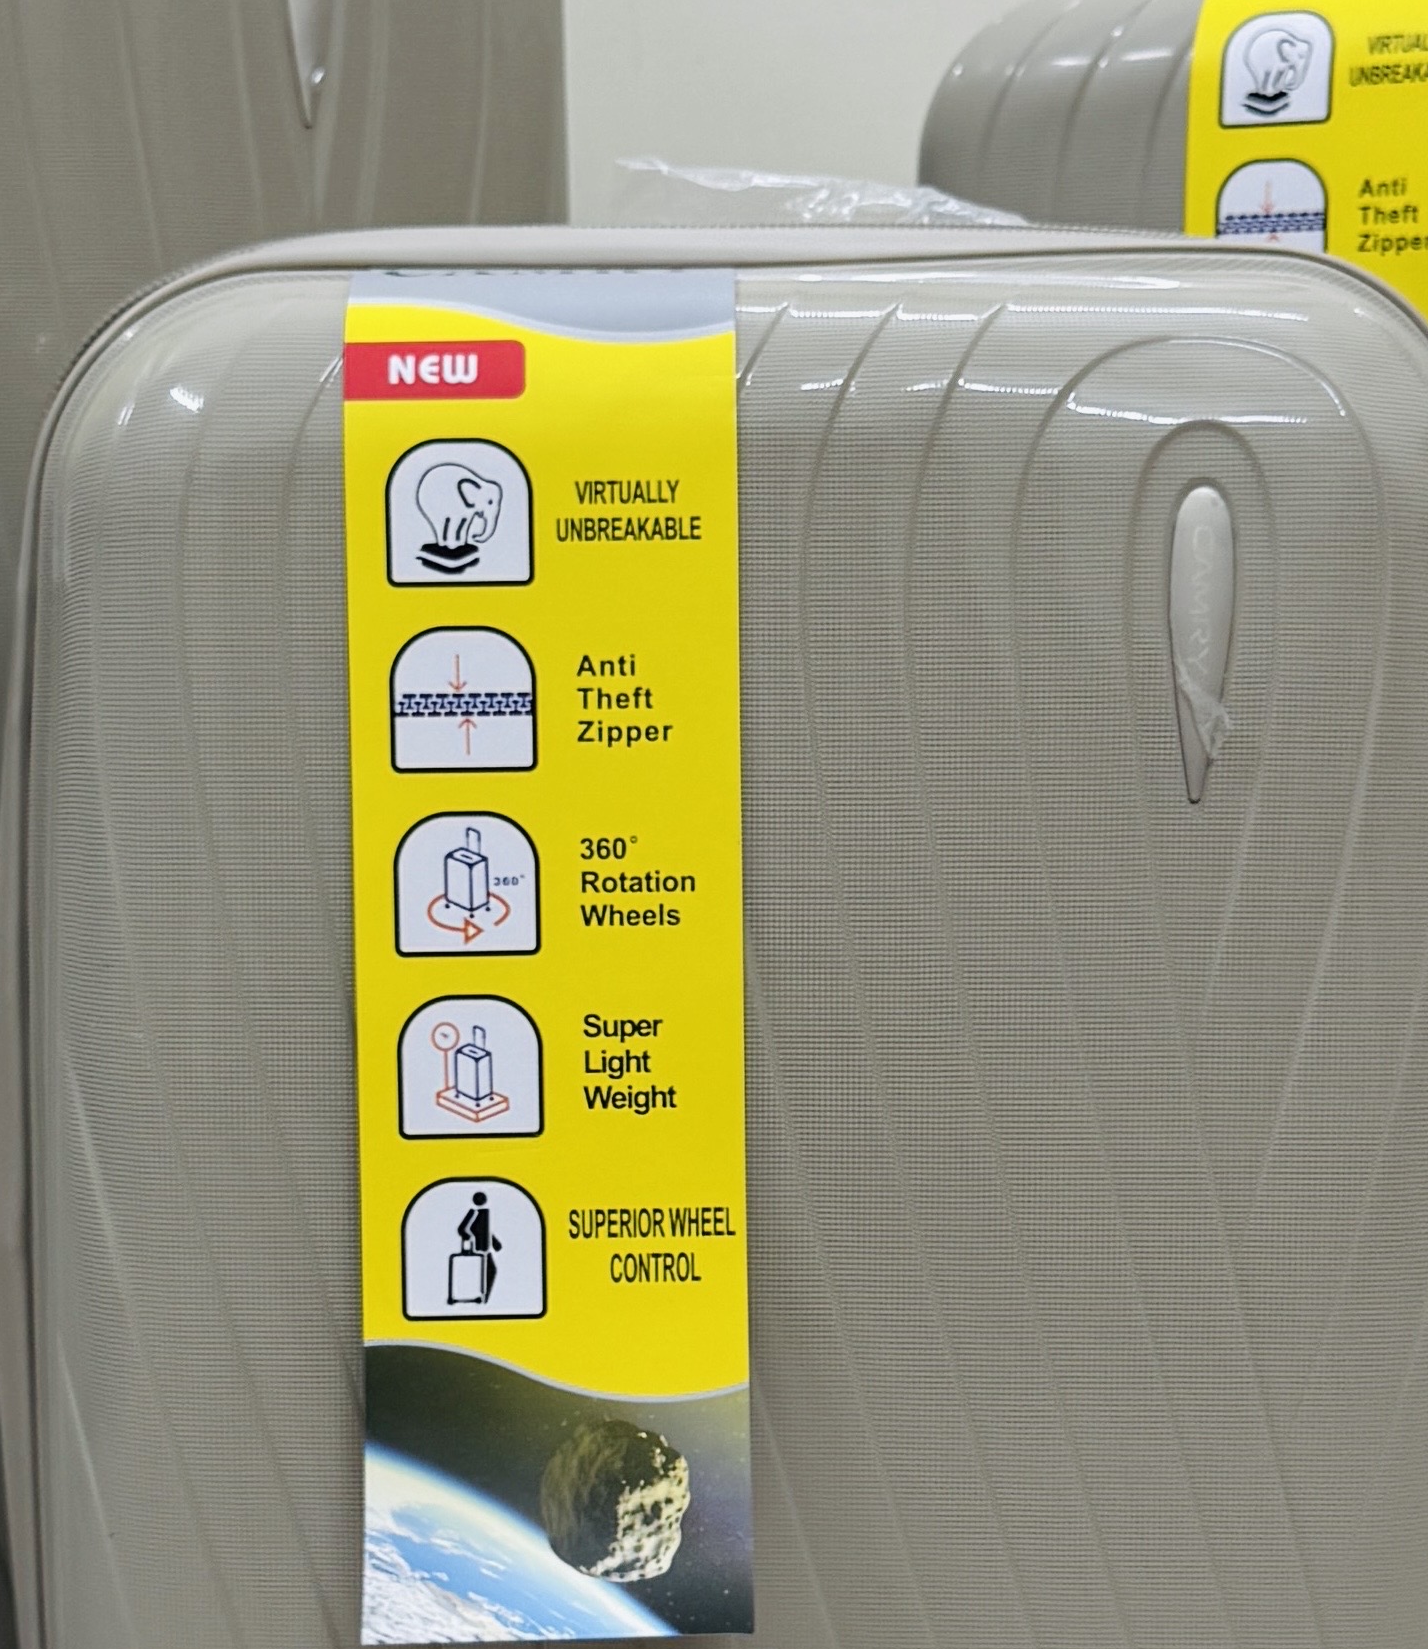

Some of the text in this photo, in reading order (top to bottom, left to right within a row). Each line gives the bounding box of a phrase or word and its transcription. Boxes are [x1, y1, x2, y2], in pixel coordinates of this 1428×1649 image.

[1359, 178, 1407, 198] Anti
[1358, 204, 1419, 225] Theft
[388, 353, 478, 385] NEW
[574, 479, 680, 505] VIRTUALLY
[556, 515, 702, 543] UNBREAKABLE
[576, 653, 636, 677] Anti
[576, 686, 653, 710] Theft
[577, 720, 673, 748] Zipper
[580, 835, 638, 860] 360°
[581, 869, 696, 894] Rotation
[580, 903, 681, 927] Wheels
[583, 1013, 663, 1041] Super
[584, 1048, 652, 1077] Light
[583, 1084, 678, 1116] Weight
[568, 1206, 737, 1240] SUPERIOR WHEEL
[610, 1251, 702, 1284] CONTROL
